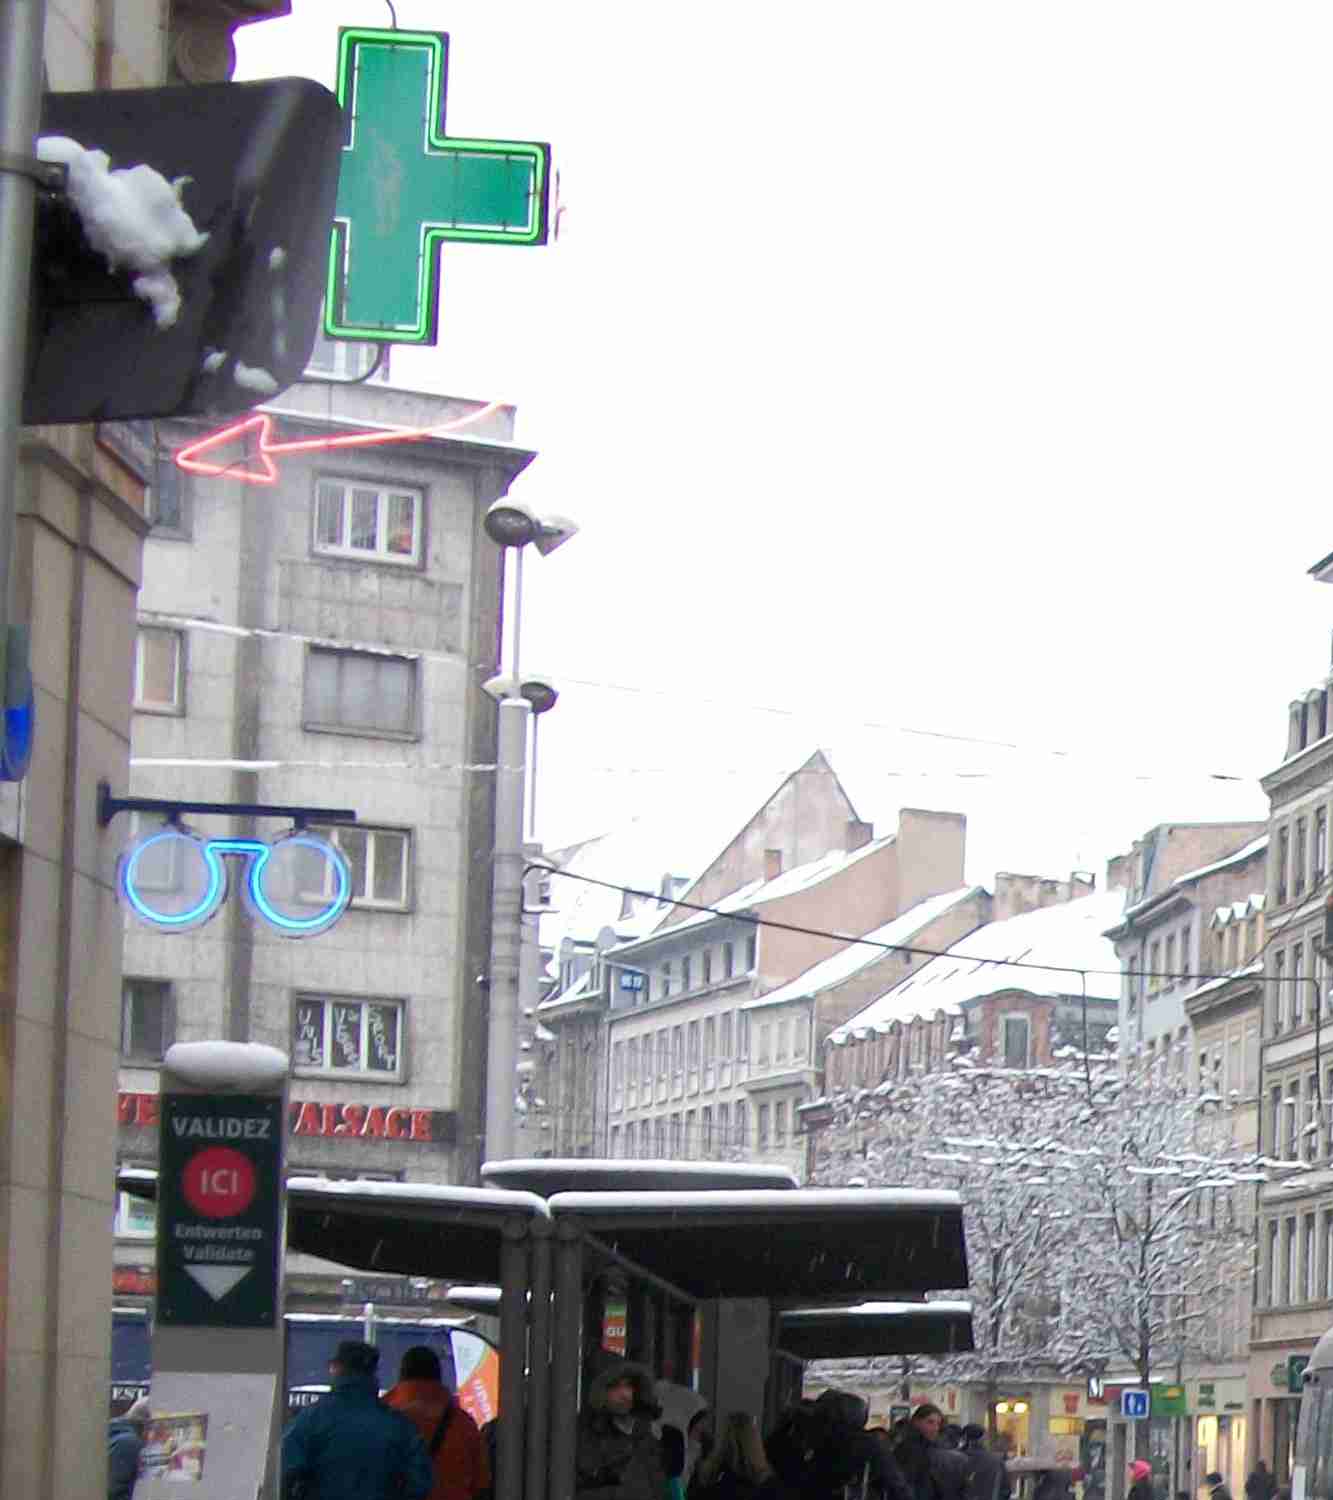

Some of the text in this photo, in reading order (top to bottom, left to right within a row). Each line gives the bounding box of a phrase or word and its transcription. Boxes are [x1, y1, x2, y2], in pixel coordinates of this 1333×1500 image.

[171, 1117, 272, 1139] VALIDEZ
[200, 1168, 239, 1196] ICI
[175, 1223, 262, 1240] Entwerten
[183, 1244, 254, 1261] Validate
